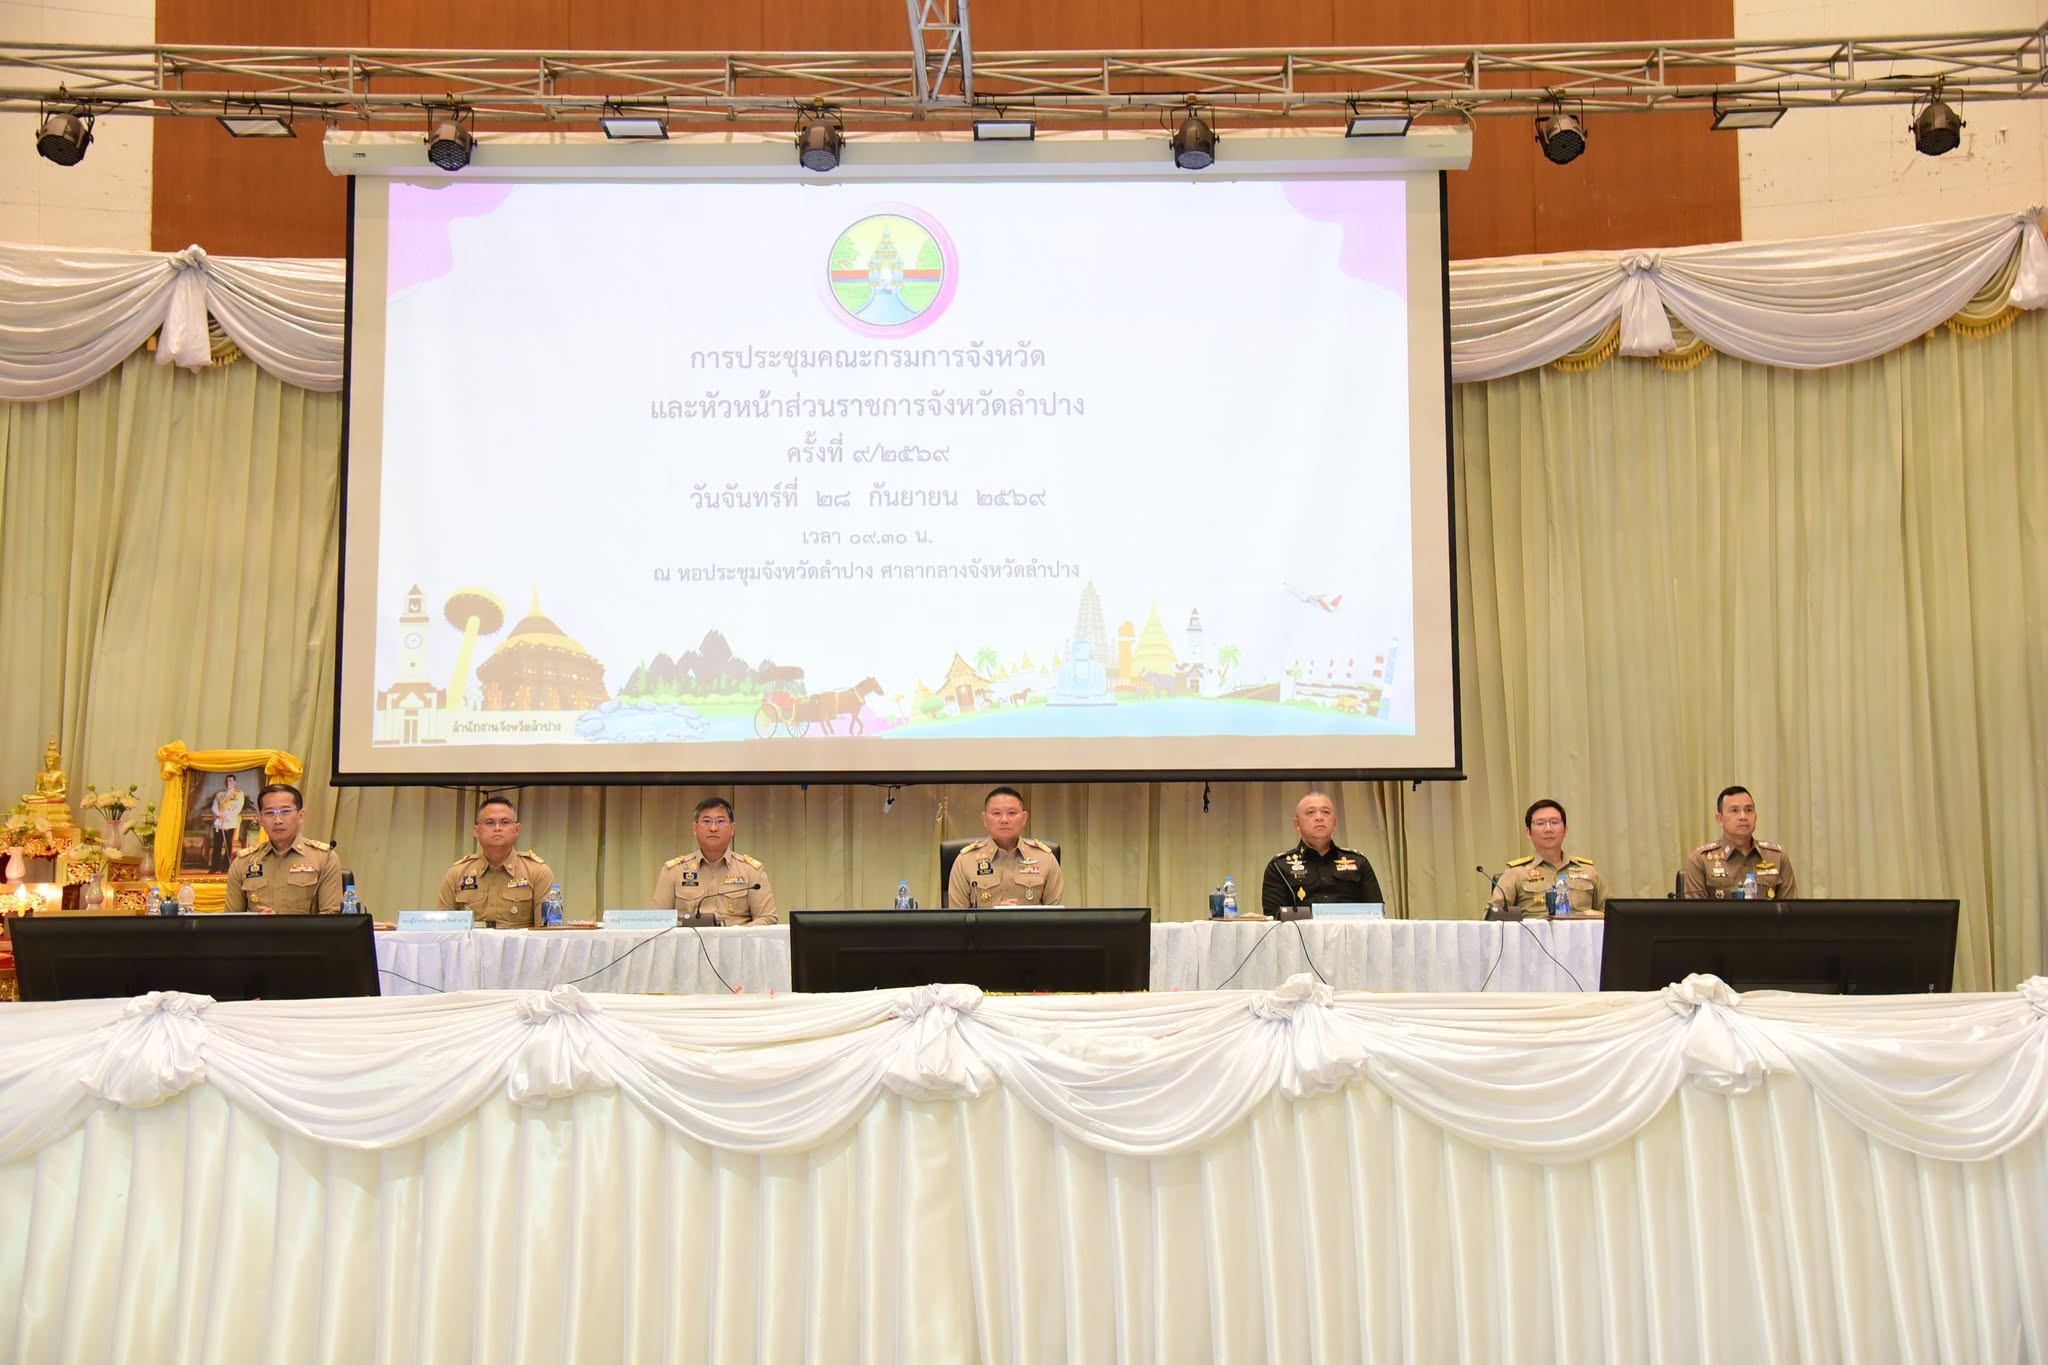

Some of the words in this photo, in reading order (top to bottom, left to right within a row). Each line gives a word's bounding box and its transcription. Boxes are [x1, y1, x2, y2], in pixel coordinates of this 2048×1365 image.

[690, 340, 1045, 377] การประชุมคณะกรมการจังหวัด
[651, 388, 1085, 420] และหัวหน้าส่วนราชการจังหวัดลำปาง
[787, 430, 843, 464] ครั้งที่
[852, 442, 950, 464] ๙/๒๕๖๙
[689, 476, 798, 509] วันจันทร์ที่
[816, 490, 851, 508] ๒๘
[869, 481, 959, 507] กันยายน
[975, 488, 1046, 507] ๒๕๖๙
[802, 530, 841, 545] เวลา
[849, 530, 908, 545] ๐๙.๓๐
[914, 529, 933, 545] น.
[654, 567, 671, 582] ณ
[677, 559, 874, 587] หอประชุมจังหวัดลำปาง
[880, 557, 1080, 579] ศาลากลางจังหวัดลำปาง
